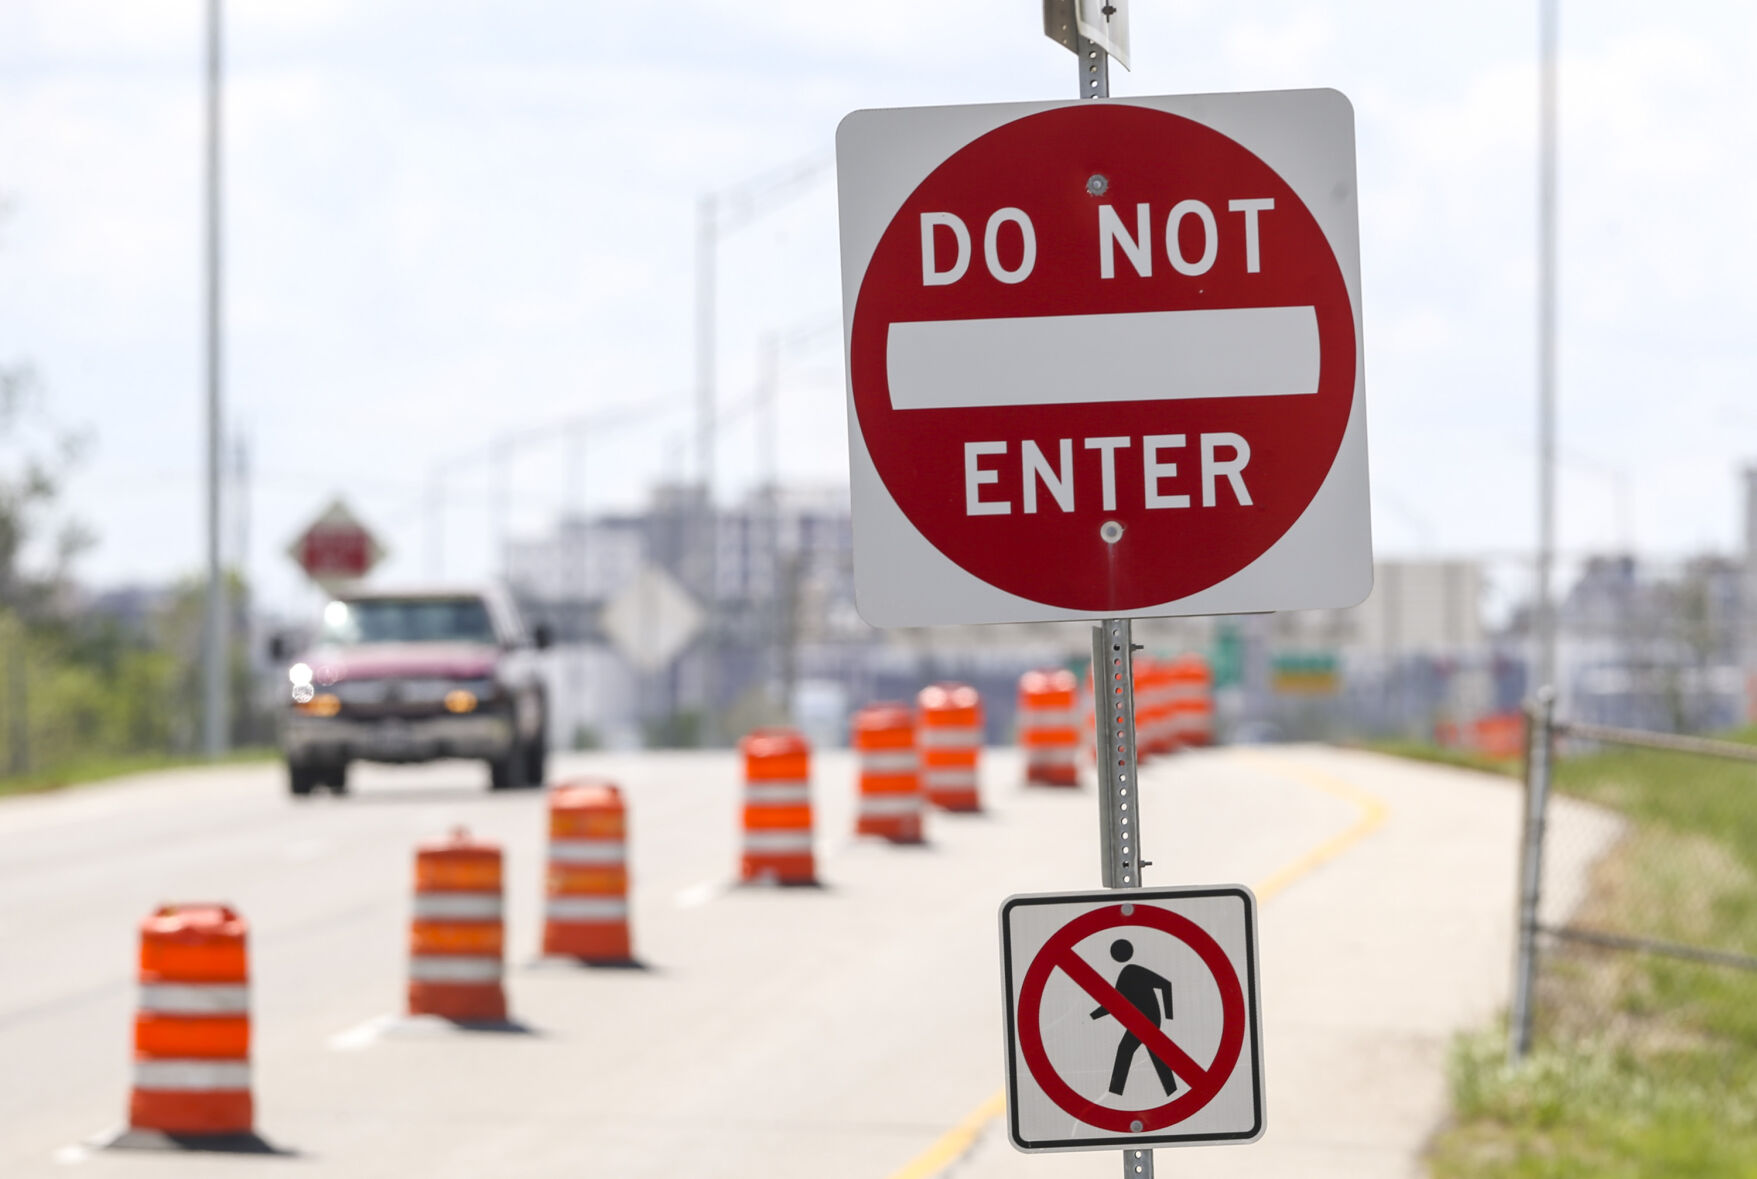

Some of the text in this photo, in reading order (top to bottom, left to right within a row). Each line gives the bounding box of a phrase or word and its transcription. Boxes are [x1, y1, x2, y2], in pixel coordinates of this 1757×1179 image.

[920, 198, 1275, 287] DO NOT
[964, 432, 1254, 516] ENTER
